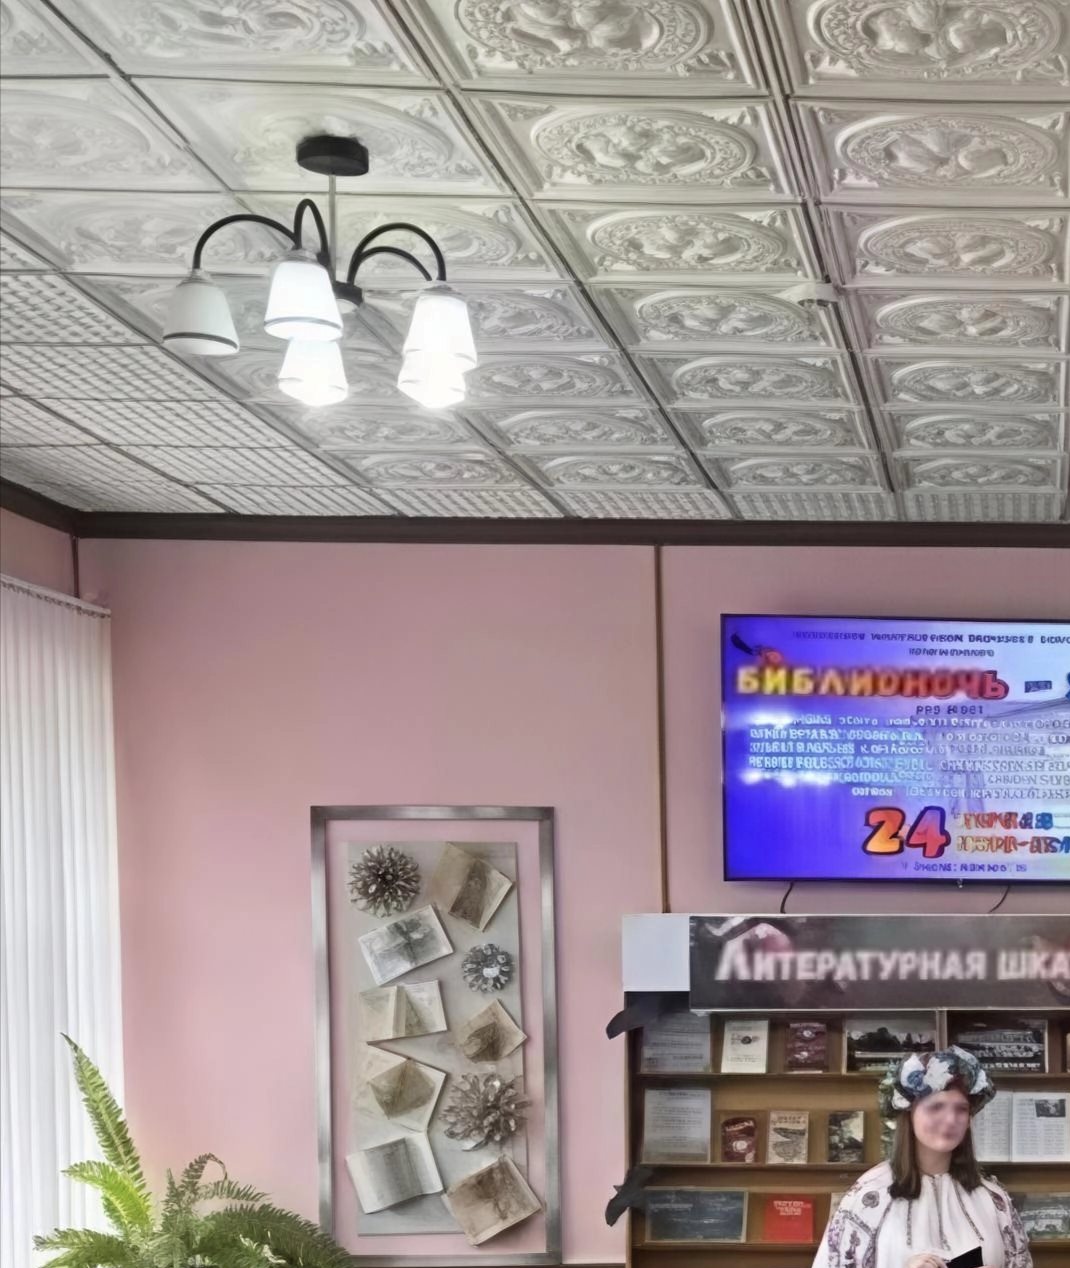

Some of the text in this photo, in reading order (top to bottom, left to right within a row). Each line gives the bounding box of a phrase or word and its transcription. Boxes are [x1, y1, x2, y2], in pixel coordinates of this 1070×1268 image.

[736, 667, 1009, 701] БИБЛИОНОЧЬ
[862, 806, 951, 858] 24
[715, 941, 986, 981] ЛИТЕРАТУРНАЯ
